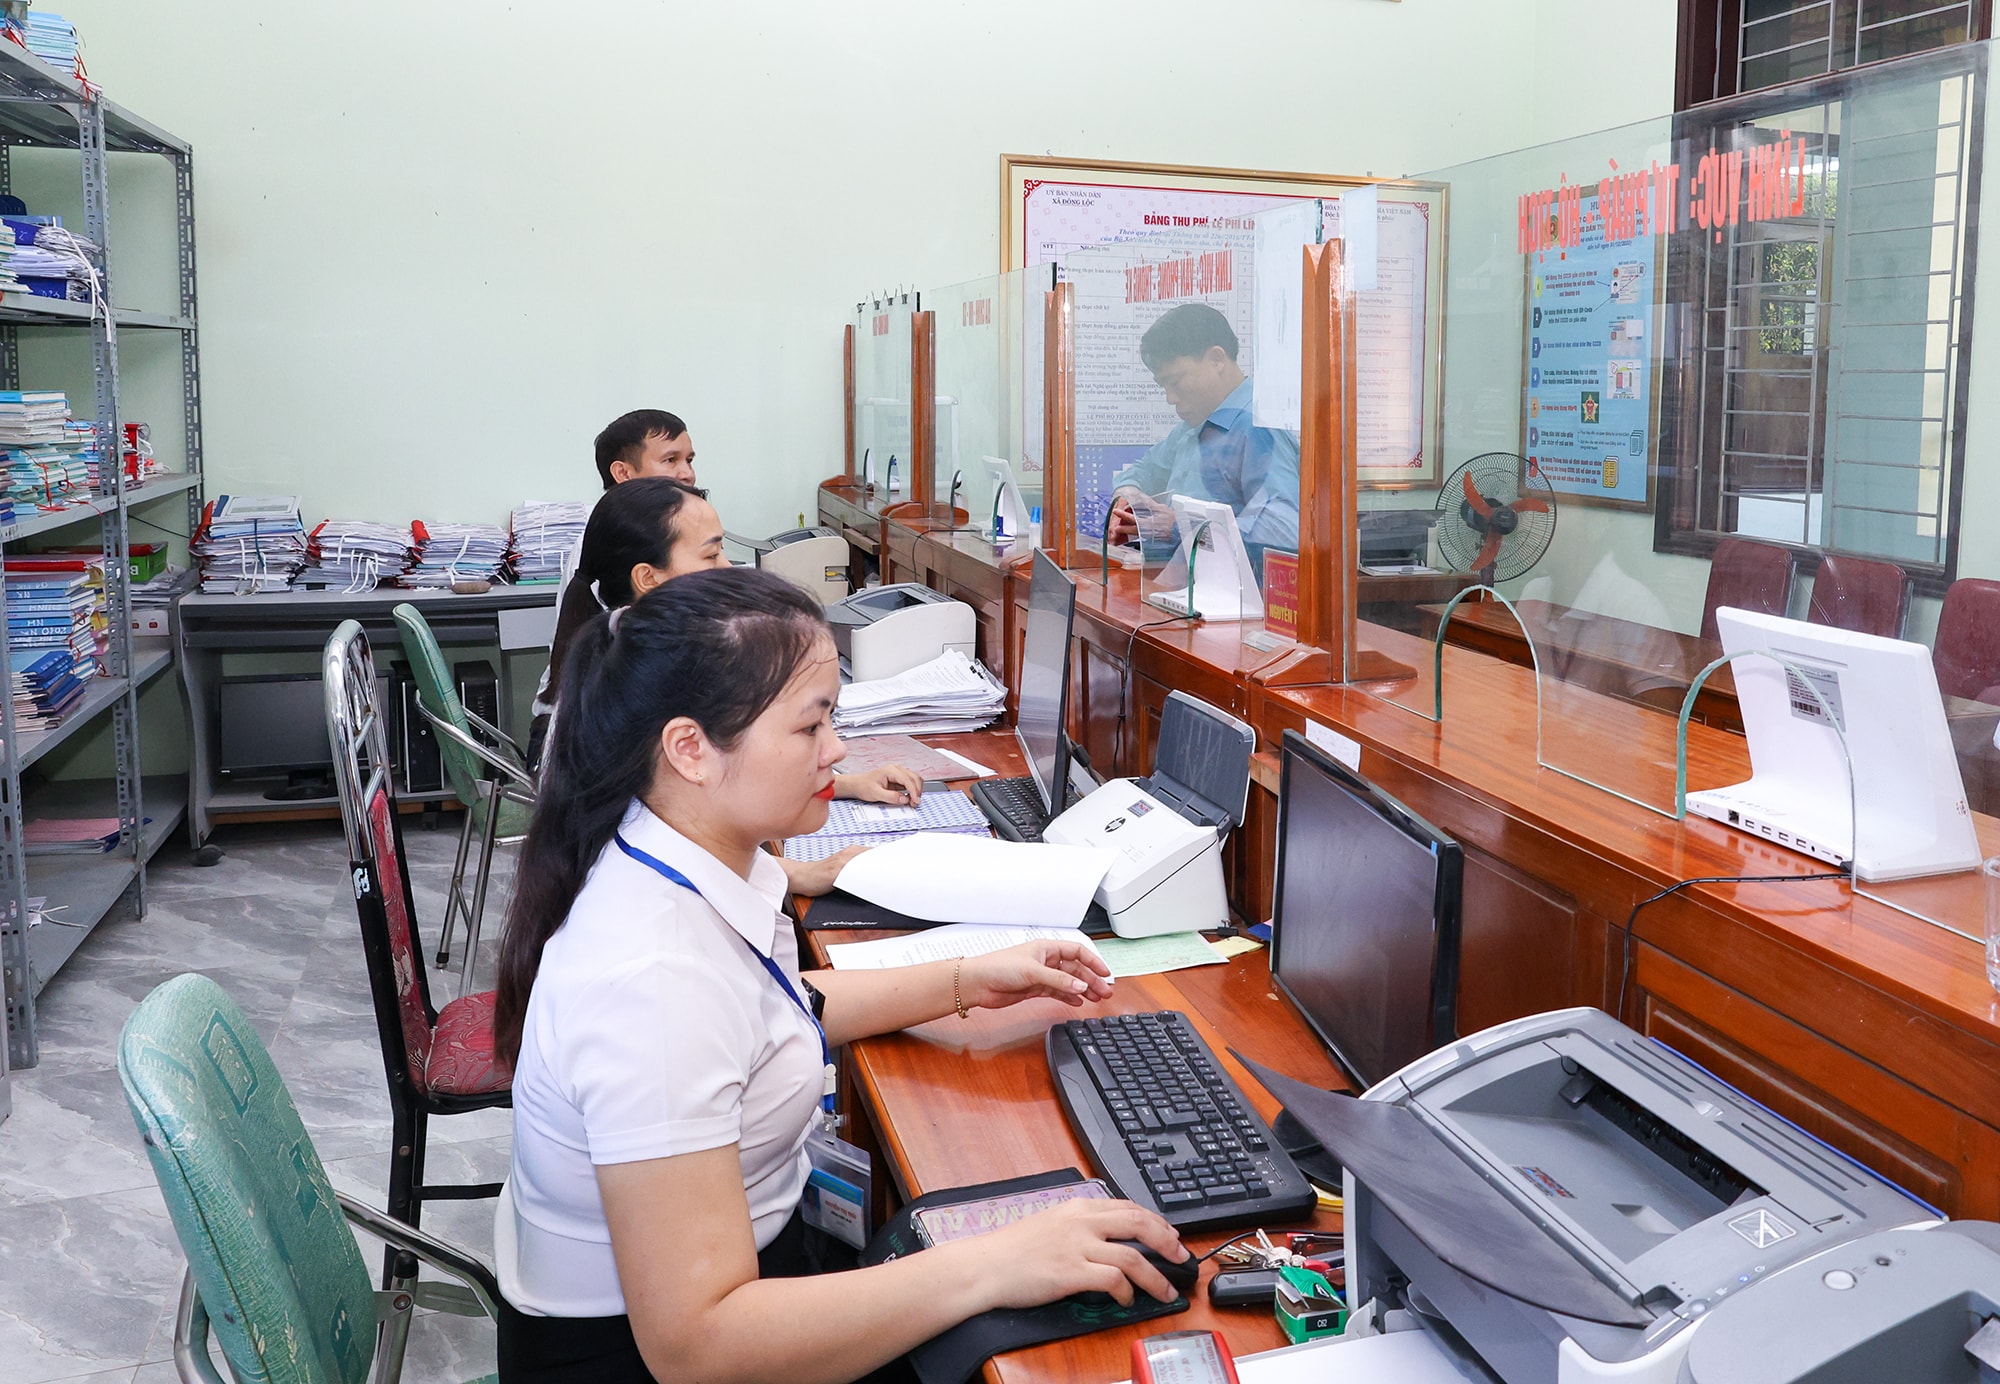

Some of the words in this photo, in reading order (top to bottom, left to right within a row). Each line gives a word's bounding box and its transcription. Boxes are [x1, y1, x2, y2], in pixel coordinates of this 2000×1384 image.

[1144, 211, 1170, 226] BẢNG
[1172, 216, 1191, 227] THU
[1192, 216, 1210, 229] PHÍ,
[1212, 217, 1223, 231] LỆ
[1224, 218, 1241, 230] PHÍ
